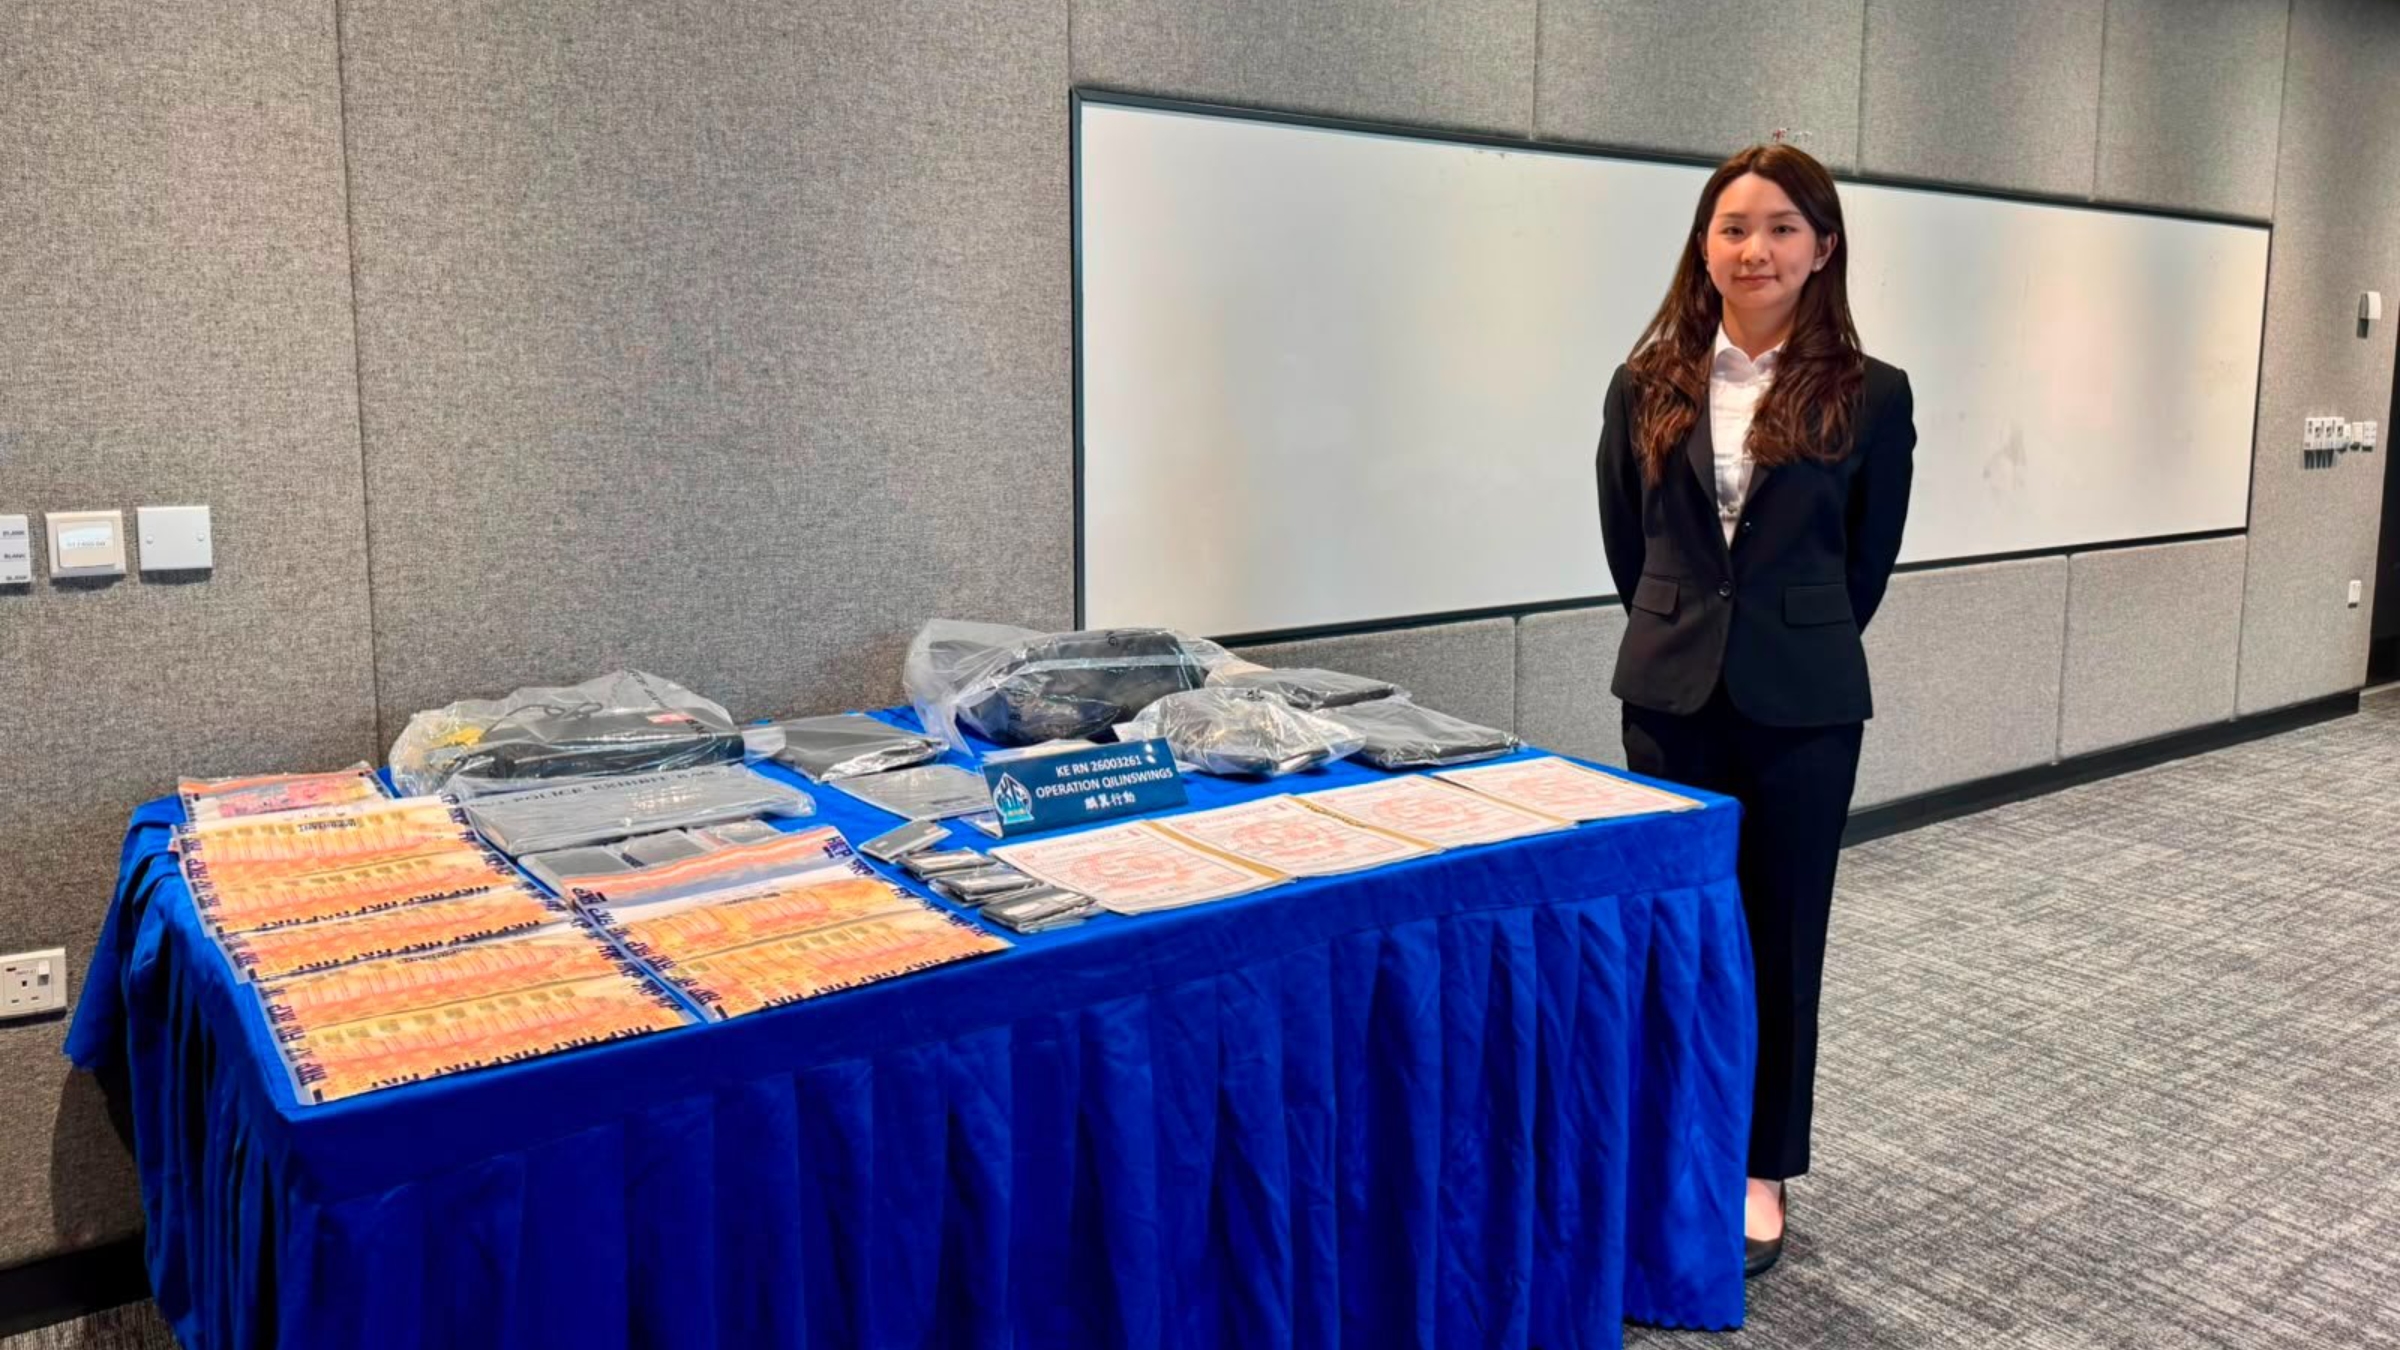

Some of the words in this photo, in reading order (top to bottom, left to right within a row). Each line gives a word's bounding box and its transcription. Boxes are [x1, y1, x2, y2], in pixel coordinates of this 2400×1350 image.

[1056, 765, 1070, 777] KE
[1072, 763, 1089, 775] RN
[1091, 755, 1142, 772] 26003261
[1035, 780, 1100, 798] OPERATION
[1102, 767, 1173, 788] QILINSWINGS
[513, 787, 583, 803] POLICE
